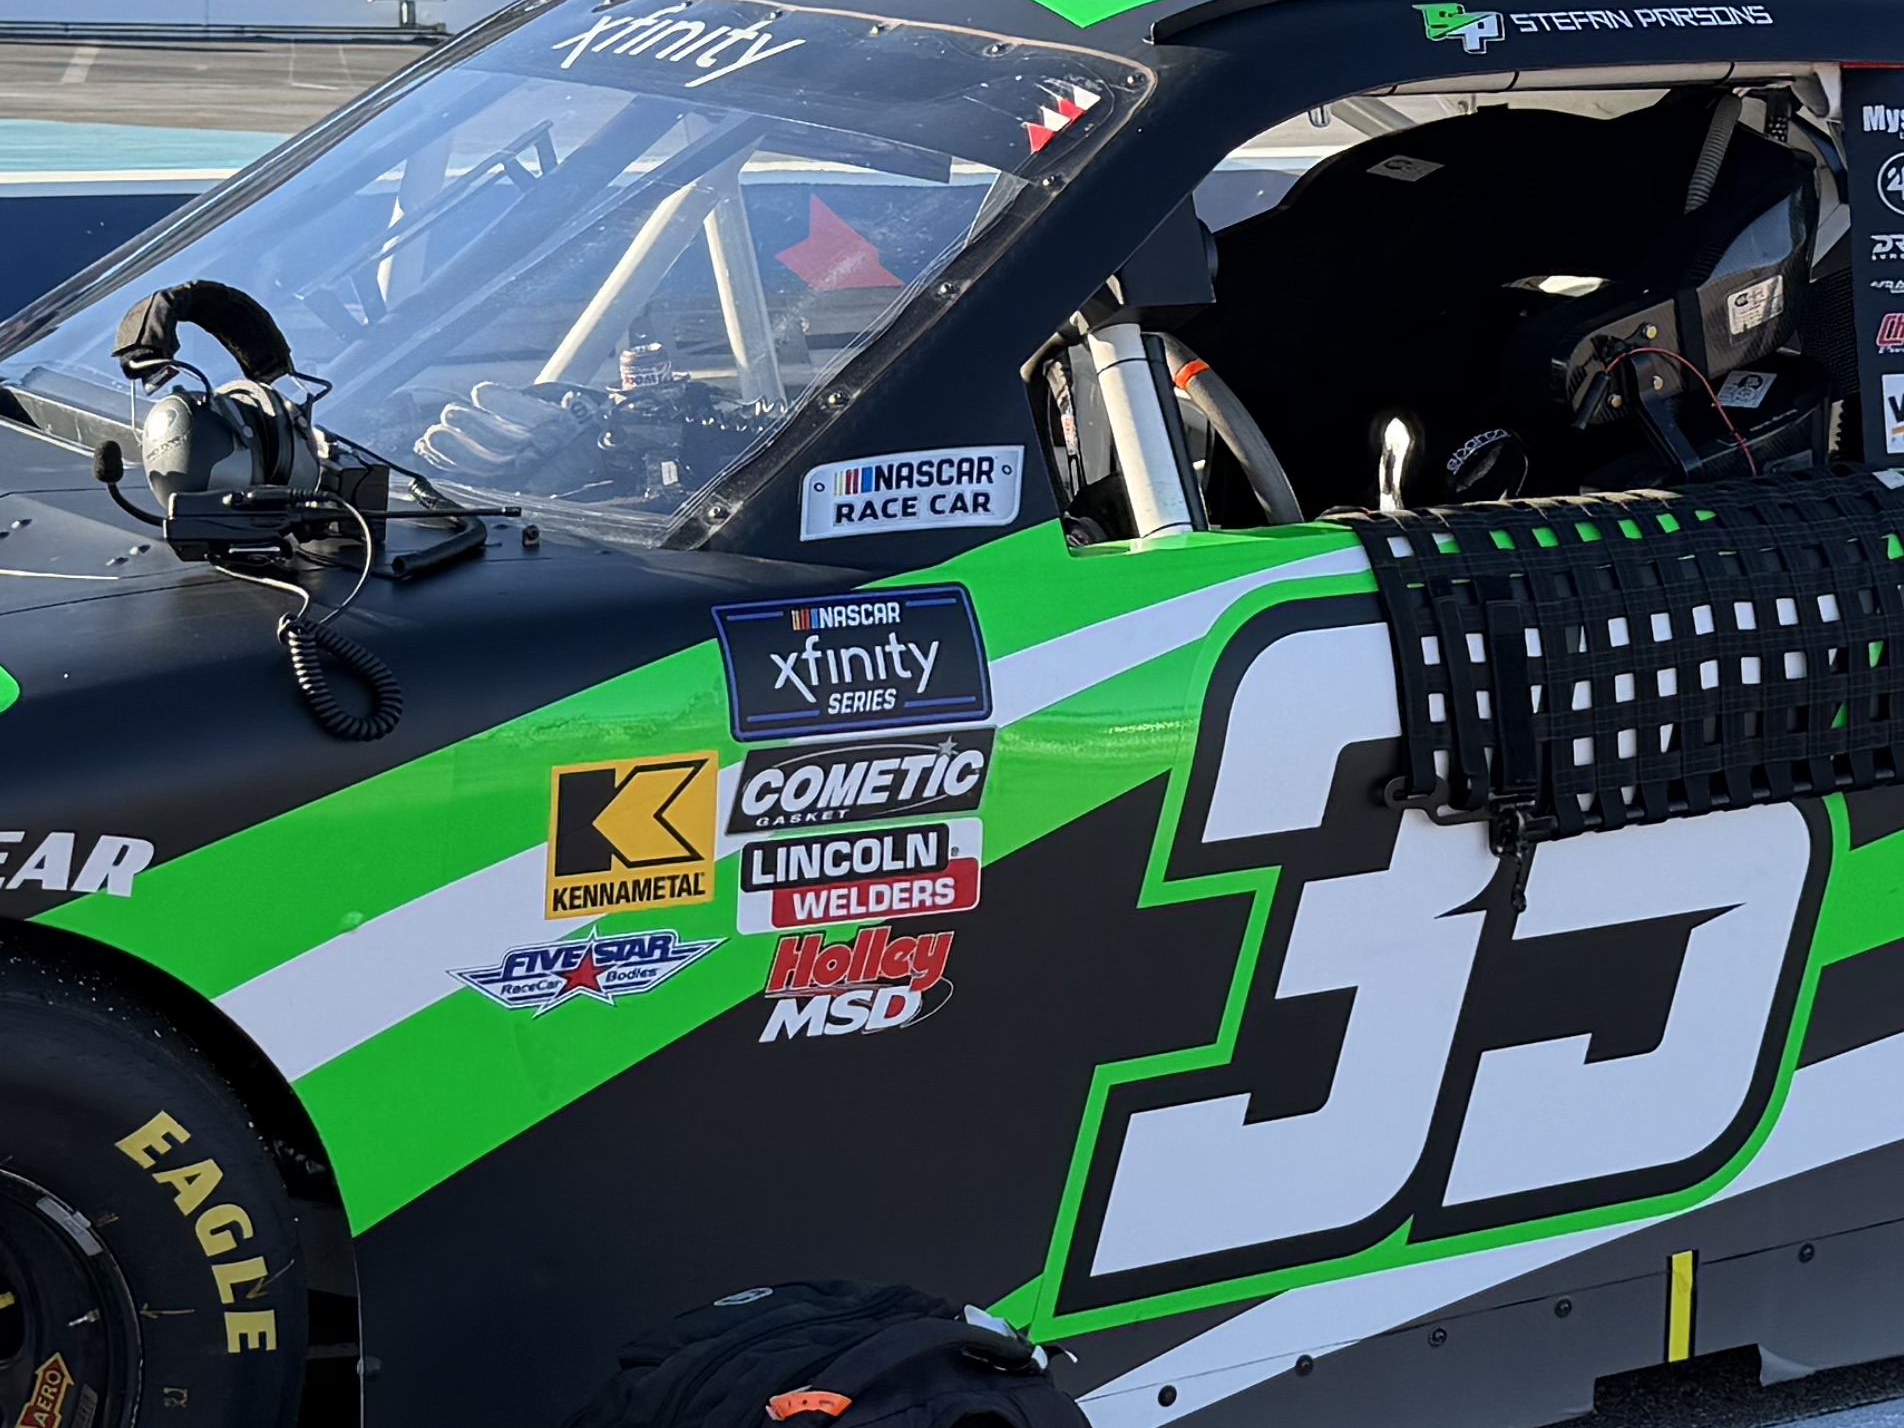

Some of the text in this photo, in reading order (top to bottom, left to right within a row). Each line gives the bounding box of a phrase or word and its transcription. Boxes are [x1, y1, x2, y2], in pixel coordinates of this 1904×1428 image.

[1510, 4, 1774, 34] STEFAN PARSONS
[551, 0, 807, 88] xfinity
[874, 456, 995, 492] NASCAR
[834, 492, 991, 524] RACE CAR
[819, 601, 901, 629] NASCAR
[769, 632, 940, 703] xfinity
[827, 688, 897, 715] SERIES
[741, 751, 985, 816] COMETIC
[755, 809, 850, 828] GASKET
[751, 831, 938, 885] LINCOLN
[552, 873, 706, 913] KENNAMETAL
[793, 876, 956, 920] WELDERS
[499, 935, 672, 980] FIVE STAR
[765, 926, 955, 994] Holley
[1088, 616, 1814, 1278] 35
[604, 967, 658, 983] Bodies
[758, 985, 922, 1043] MSD
[114, 1109, 278, 1355] EAGLE
